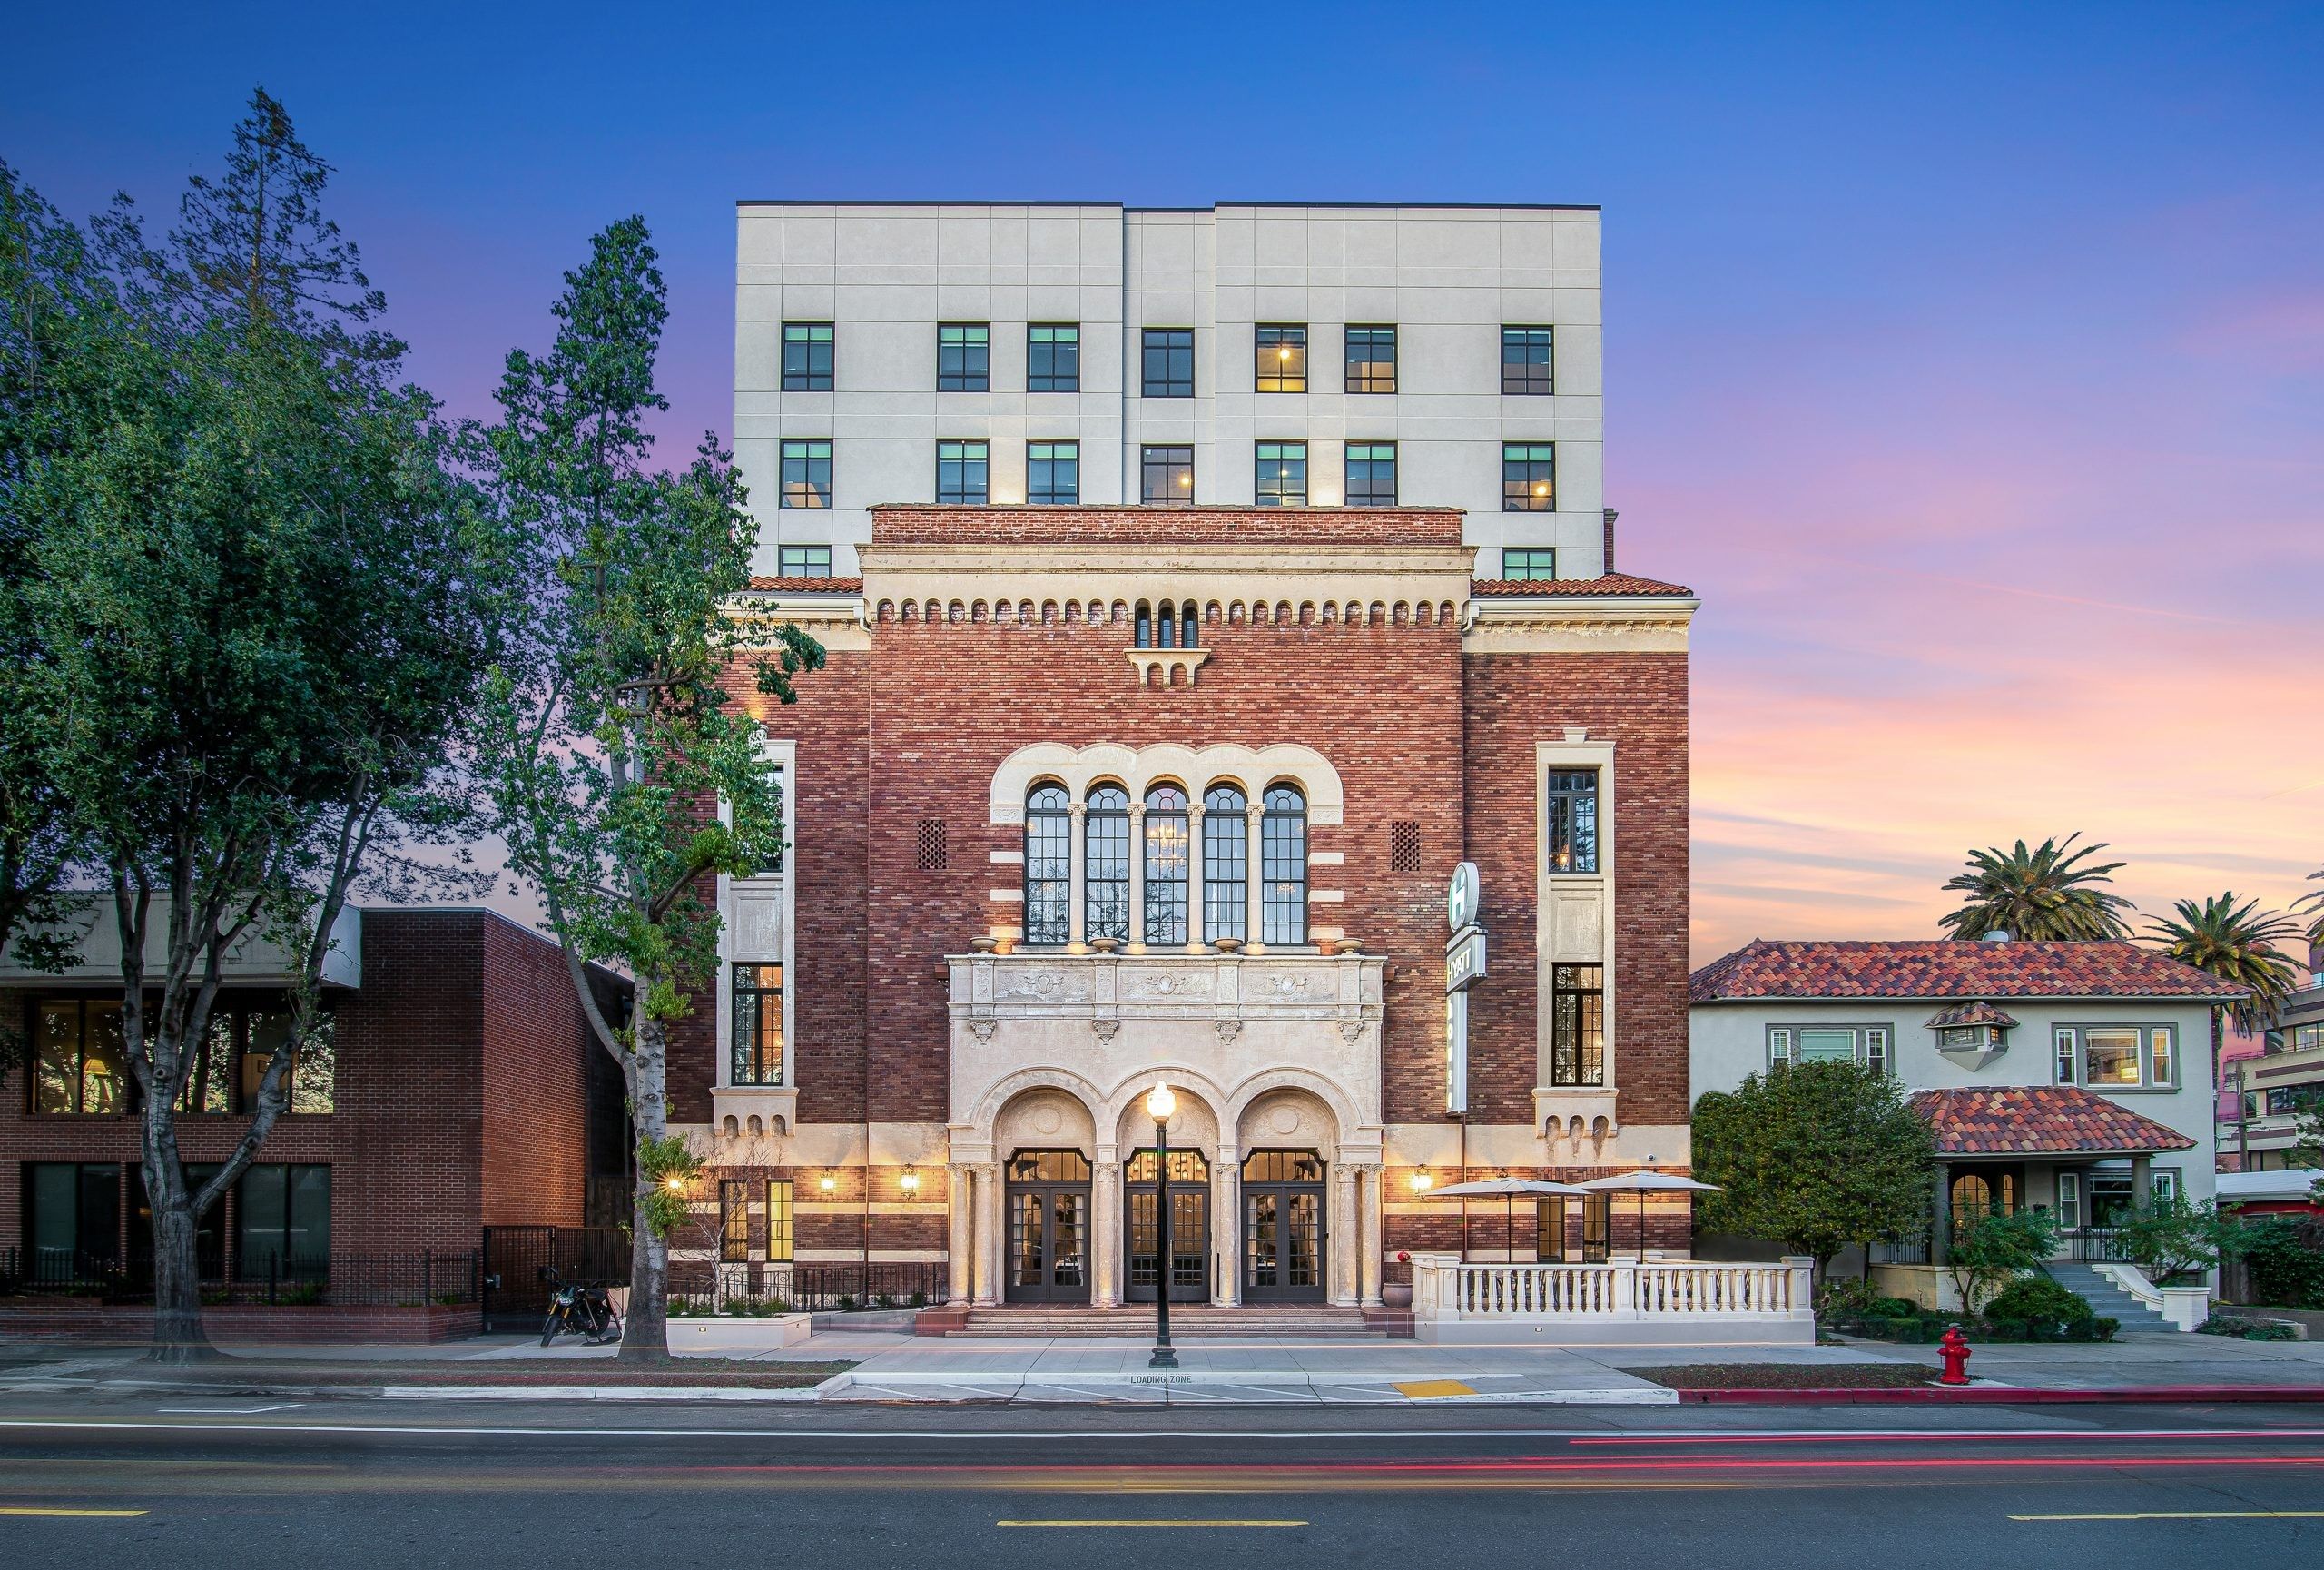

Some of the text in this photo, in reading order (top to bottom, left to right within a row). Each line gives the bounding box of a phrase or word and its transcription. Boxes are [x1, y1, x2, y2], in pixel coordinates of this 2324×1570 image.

[1450, 872, 1465, 924] H
[1447, 948, 1471, 983] HYATT
[1131, 1376, 1192, 1384] LOADING ZONE
